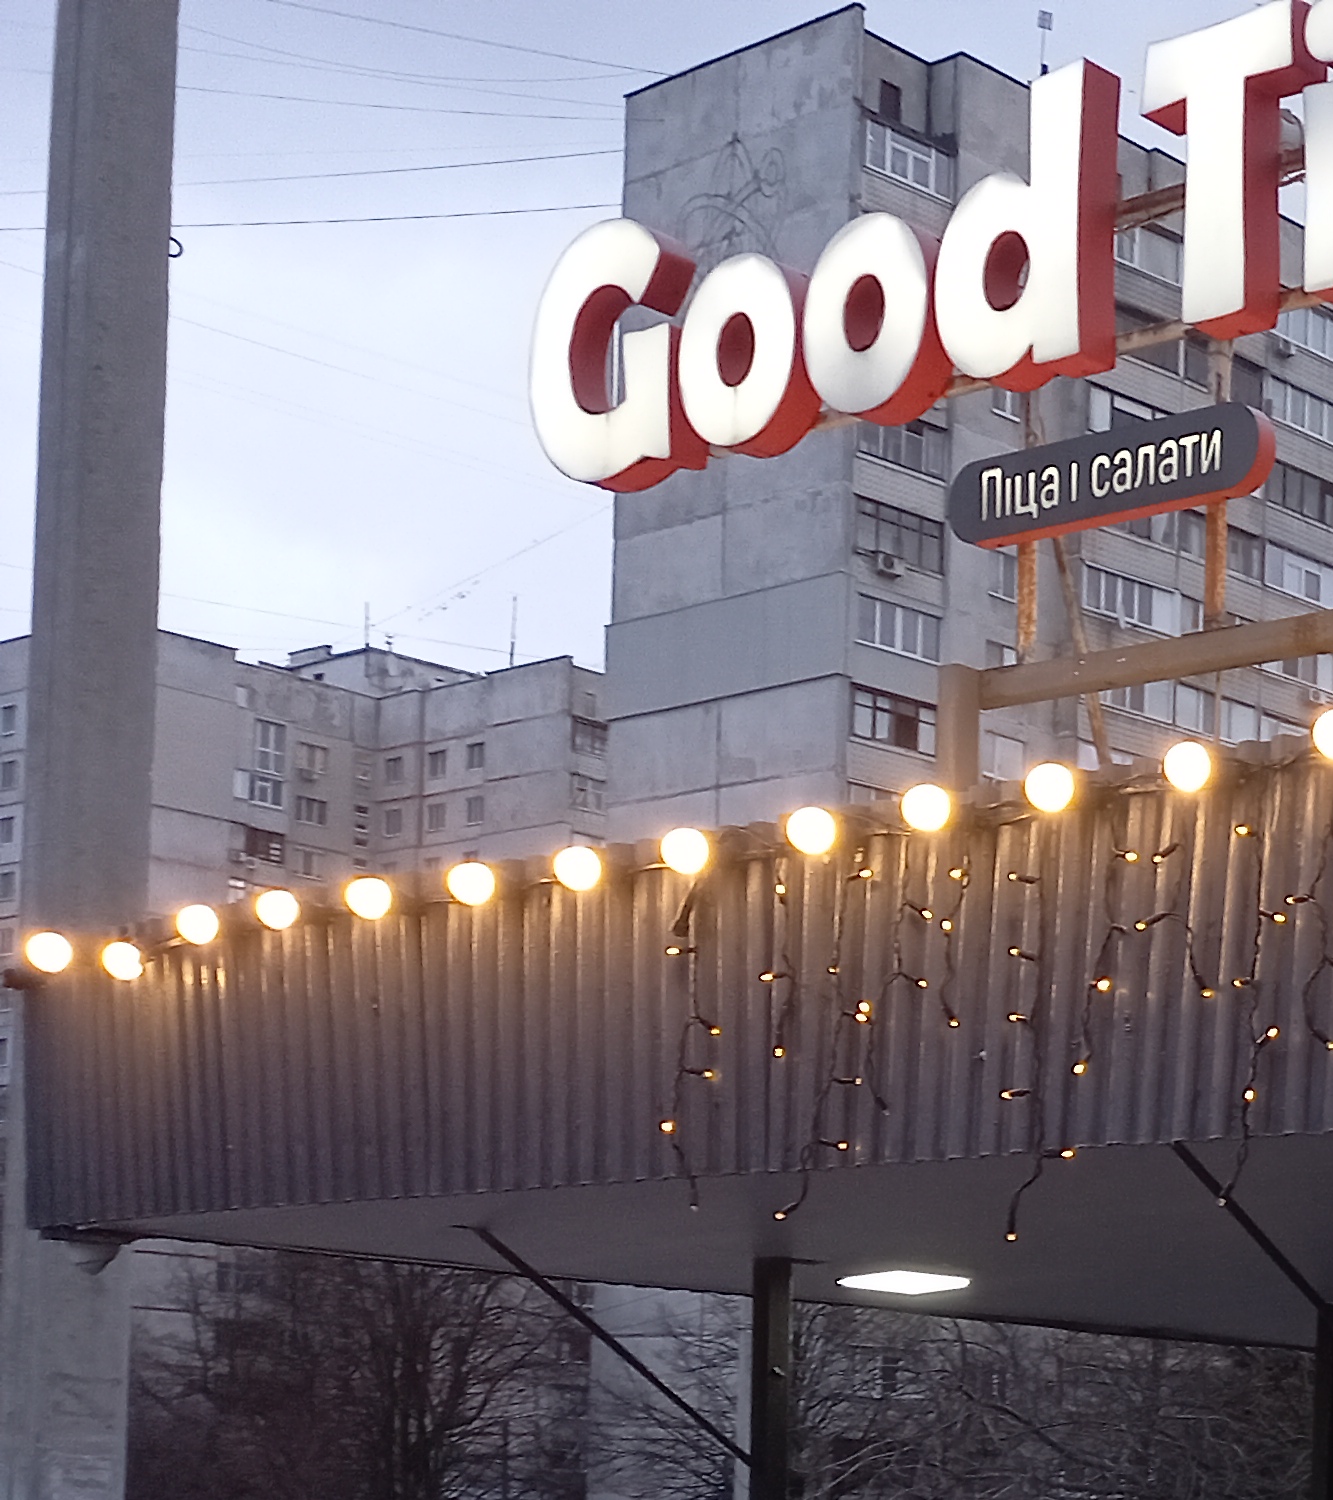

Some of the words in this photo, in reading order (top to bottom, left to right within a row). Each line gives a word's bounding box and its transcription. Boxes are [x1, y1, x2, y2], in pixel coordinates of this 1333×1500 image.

[529, 57, 1120, 492] Good
[980, 466, 1061, 522] Піца
[1091, 428, 1223, 498] салати
